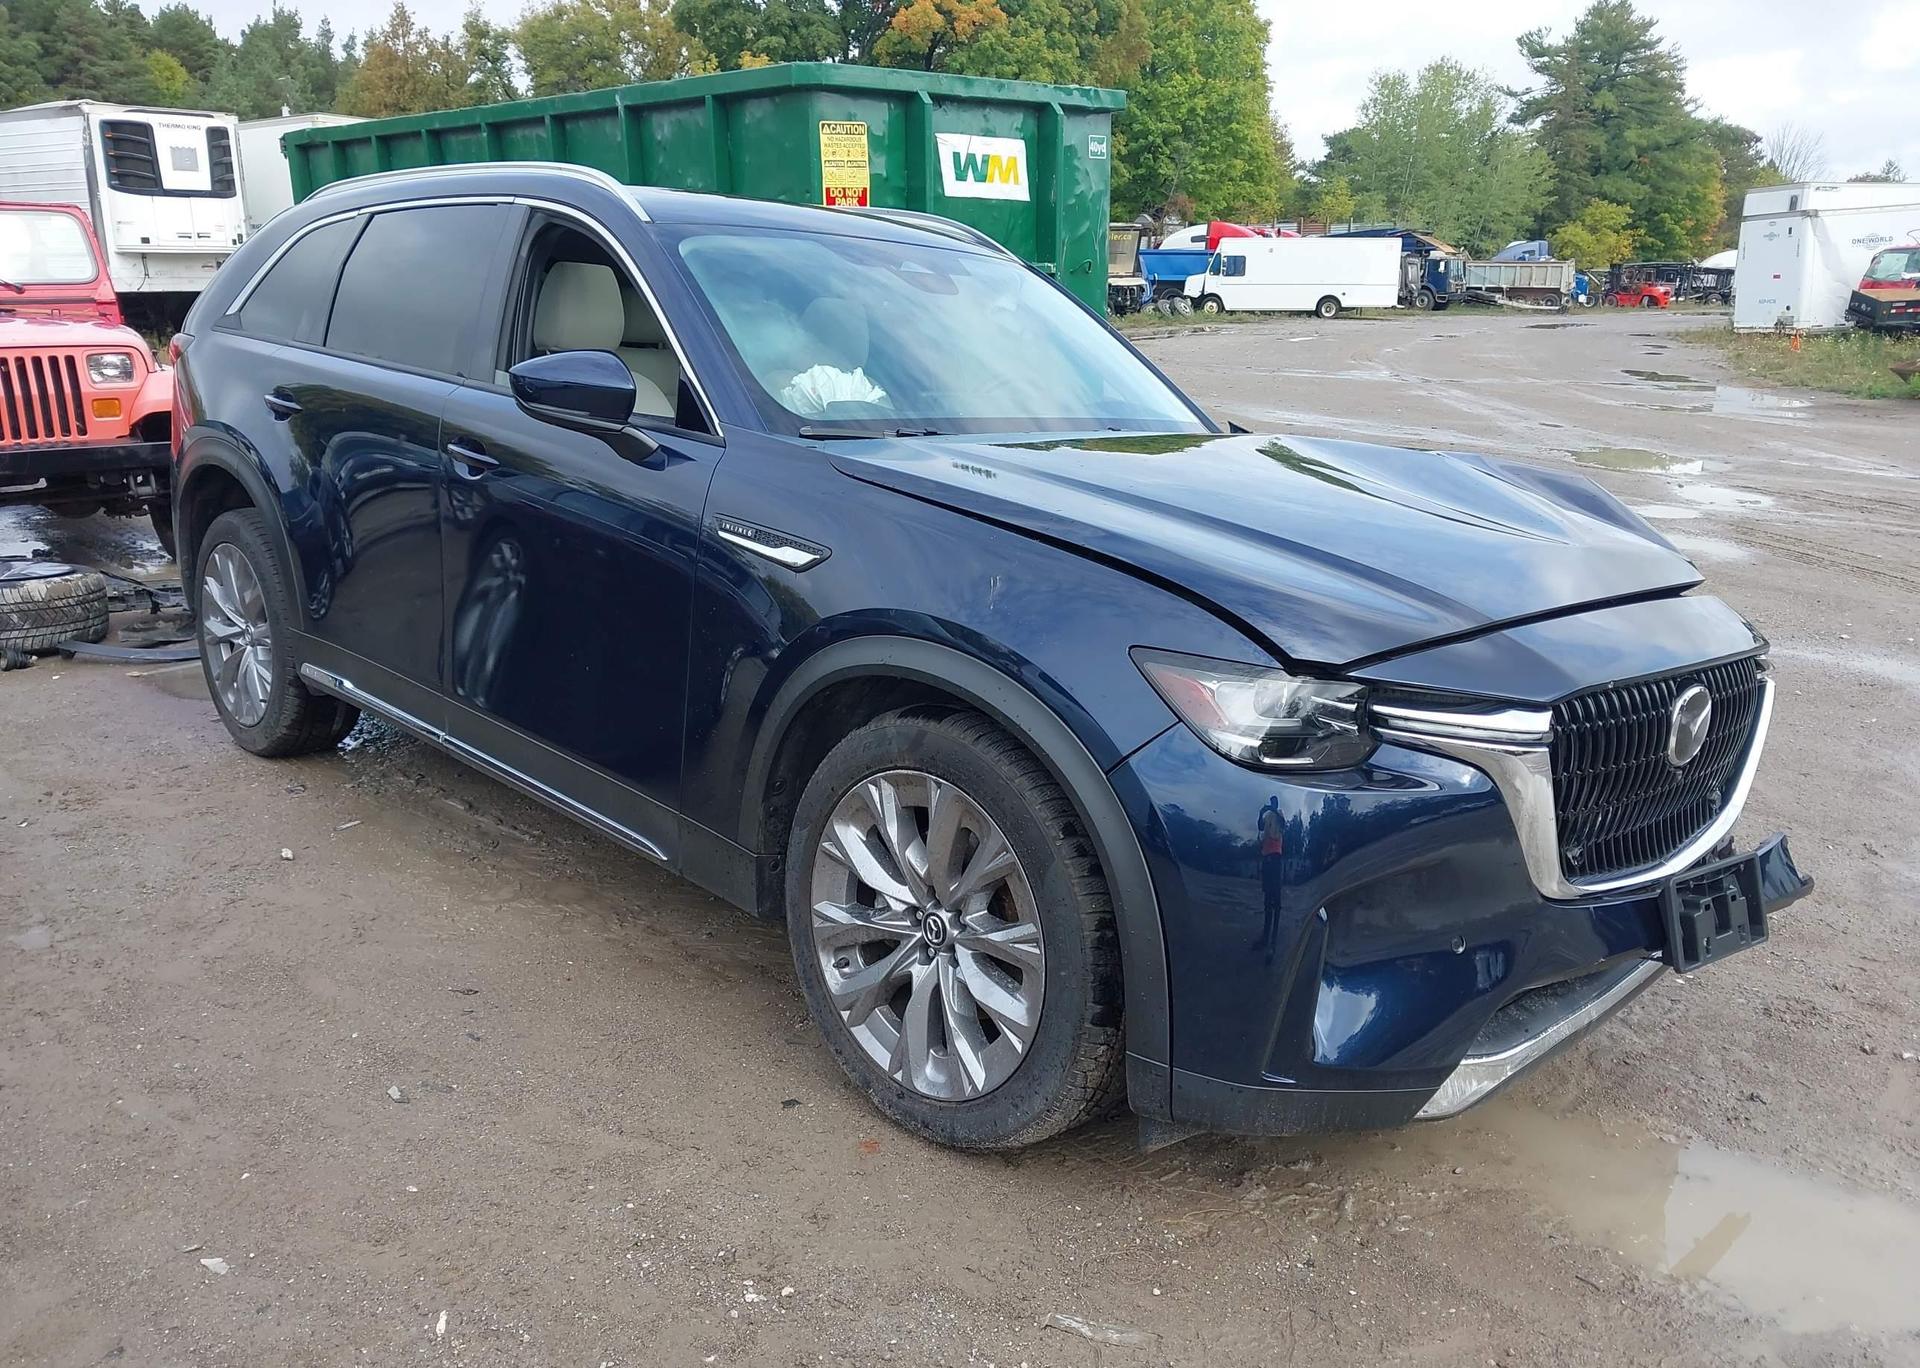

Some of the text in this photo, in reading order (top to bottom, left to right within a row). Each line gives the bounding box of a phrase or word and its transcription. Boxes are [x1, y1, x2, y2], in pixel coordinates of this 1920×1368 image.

[830, 124, 865, 134] CAUTION
[953, 151, 1020, 186] WM
[830, 187, 864, 197] DO NOT
[835, 197, 860, 207] PARK
[1109, 232, 1132, 241] ler.ca
[1868, 235, 1894, 243] WORLD
